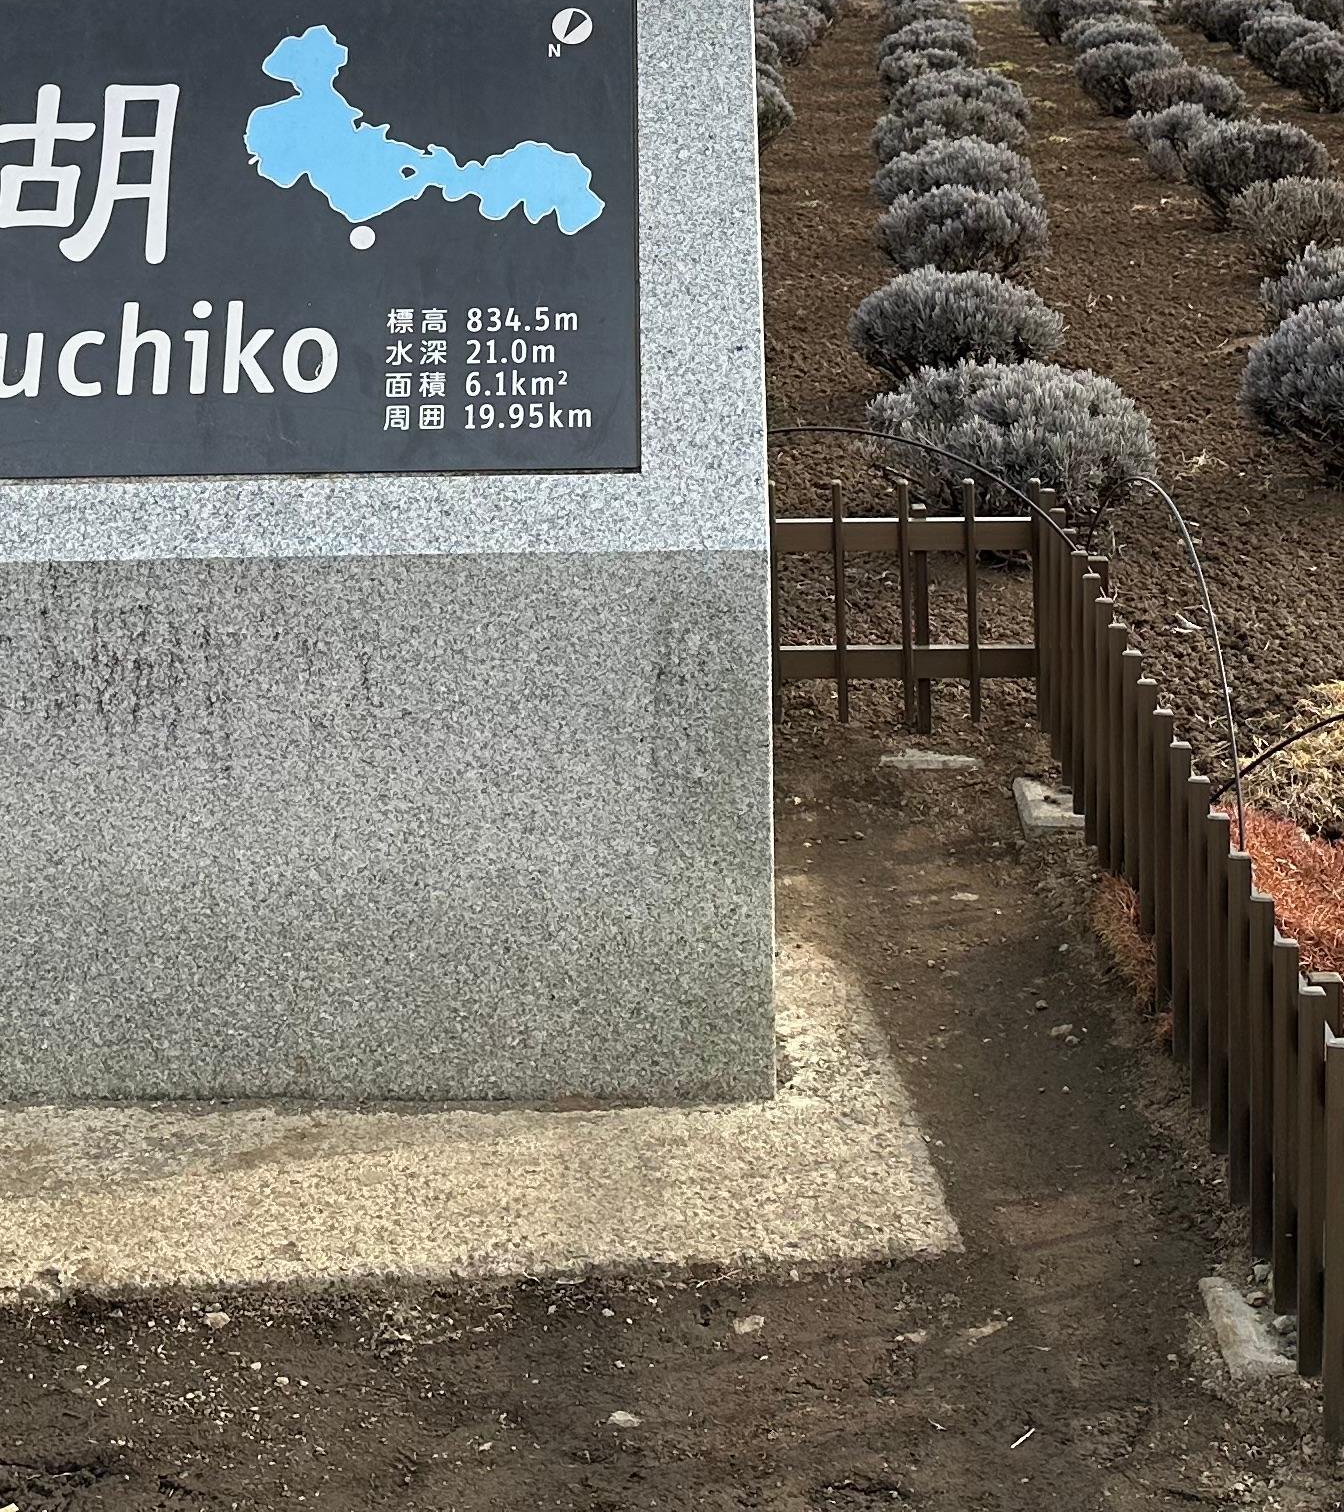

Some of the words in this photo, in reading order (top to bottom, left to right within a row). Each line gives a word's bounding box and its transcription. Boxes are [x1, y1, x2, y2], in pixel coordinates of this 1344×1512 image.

[548, 43, 561, 58] N
[386, 307, 448, 334] 標高
[466, 306, 578, 333] 834.5m
[385, 339, 448, 366] 水深
[466, 338, 555, 365] 21.0m
[385, 371, 447, 398] 面積
[383, 404, 445, 431] 周囲
[464, 401, 592, 430] 19.95km
